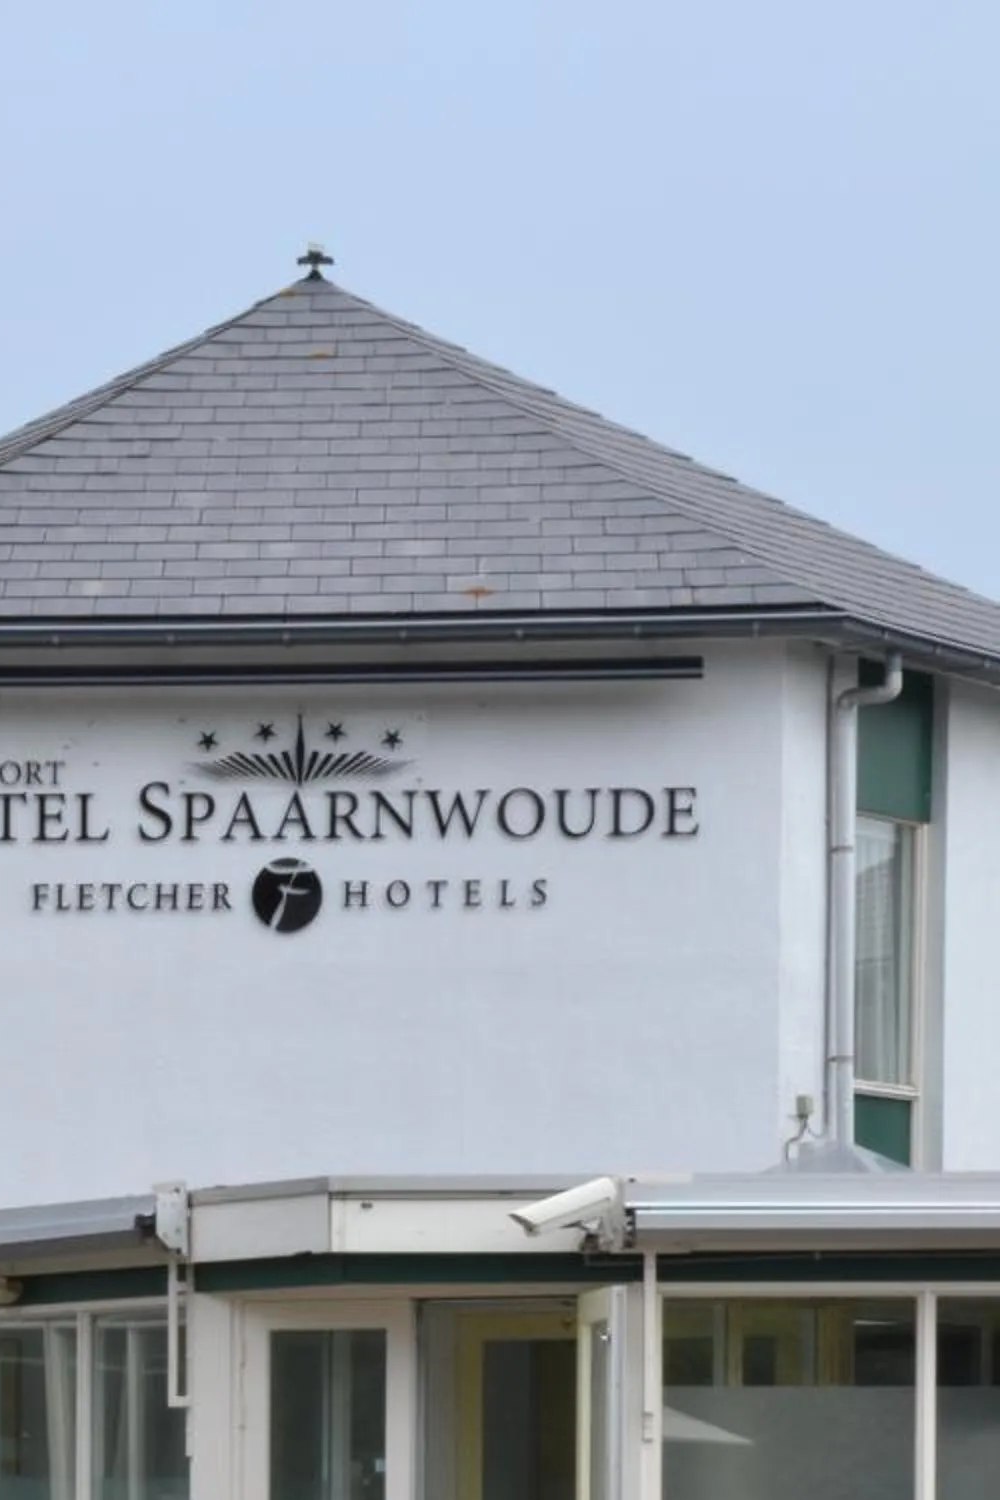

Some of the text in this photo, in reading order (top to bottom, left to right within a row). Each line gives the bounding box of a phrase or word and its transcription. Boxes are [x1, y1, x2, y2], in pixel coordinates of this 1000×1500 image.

[138, 781, 699, 843] SPAARNWOUDE
[32, 883, 232, 911] FLETCHER
[343, 879, 547, 909] HOTELS
